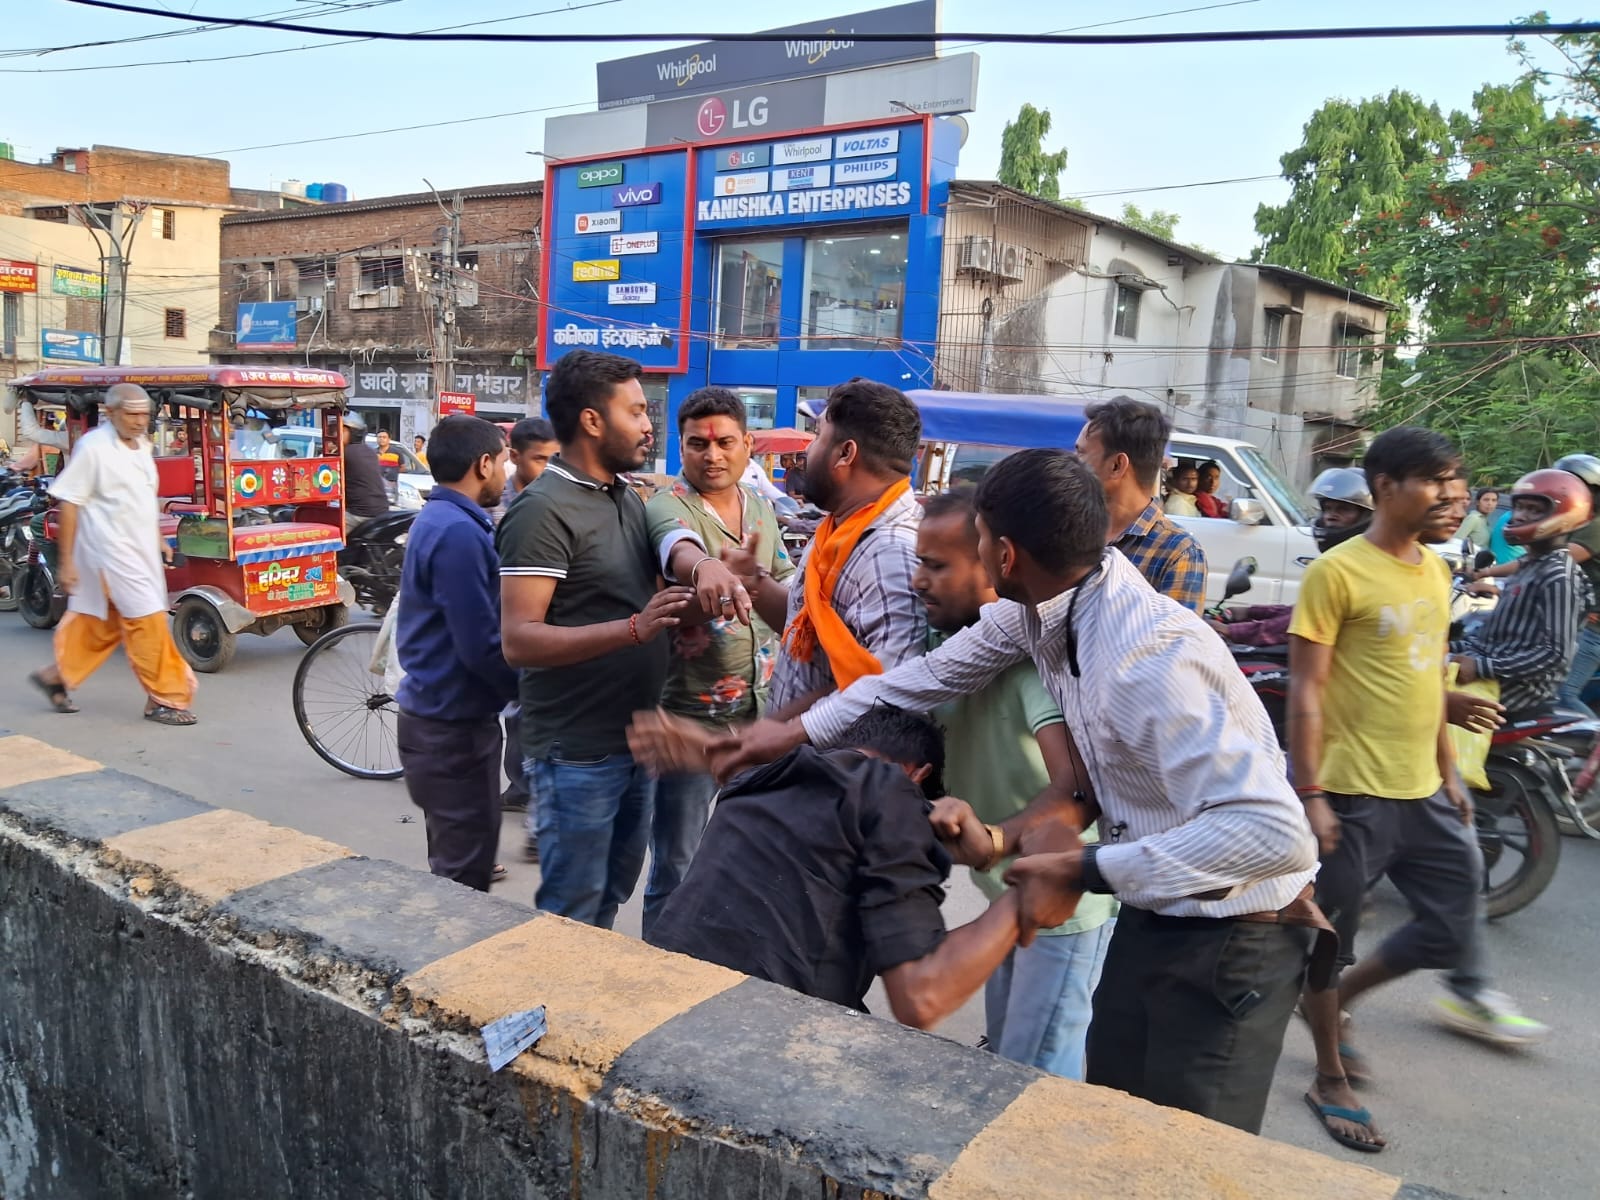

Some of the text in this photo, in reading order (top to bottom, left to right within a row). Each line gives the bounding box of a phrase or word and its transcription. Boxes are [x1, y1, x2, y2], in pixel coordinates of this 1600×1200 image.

[657, 54, 716, 80] Whirlpool
[922, 97, 964, 110] Enterprises
[732, 96, 768, 128] LG
[784, 144, 822, 158] Whirlpool
[843, 137, 890, 153] VOLTAS
[741, 152, 755, 164] LG
[790, 168, 810, 179] KENT
[843, 161, 889, 174] PHILIPS
[581, 168, 618, 181] oppo
[618, 187, 652, 203] vivo
[698, 181, 911, 221] KANISHKA ENTERPRISES
[592, 217, 617, 226] xiaomi
[626, 239, 656, 249] ONEPLUS
[616, 285, 648, 294] SAMSUNG
[360, 366, 398, 392] खादी
[476, 369, 523, 395] भंडार
[447, 395, 472, 406] PARCO
[258, 562, 300, 592] हरिहर
